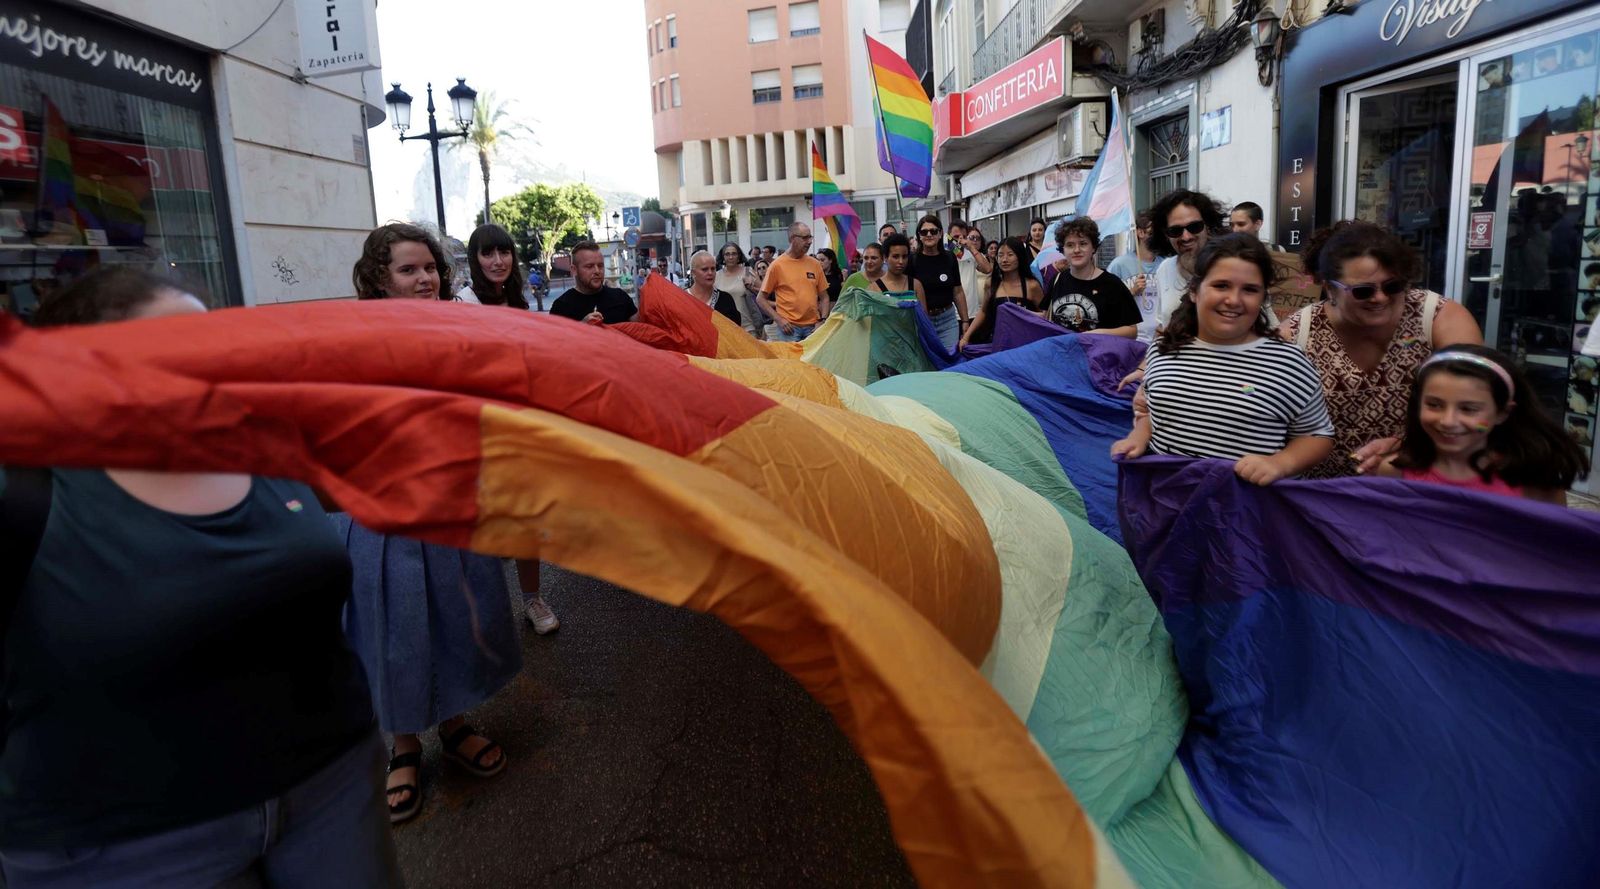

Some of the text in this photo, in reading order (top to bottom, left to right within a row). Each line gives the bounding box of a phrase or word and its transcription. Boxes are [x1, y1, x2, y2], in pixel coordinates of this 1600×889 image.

[326, 0, 340, 51] ral
[1380, 0, 1492, 46] Visag
[113, 49, 202, 93] marcas
[967, 58, 1057, 122] CONFITERIA
[1290, 157, 1303, 246] ESTE
